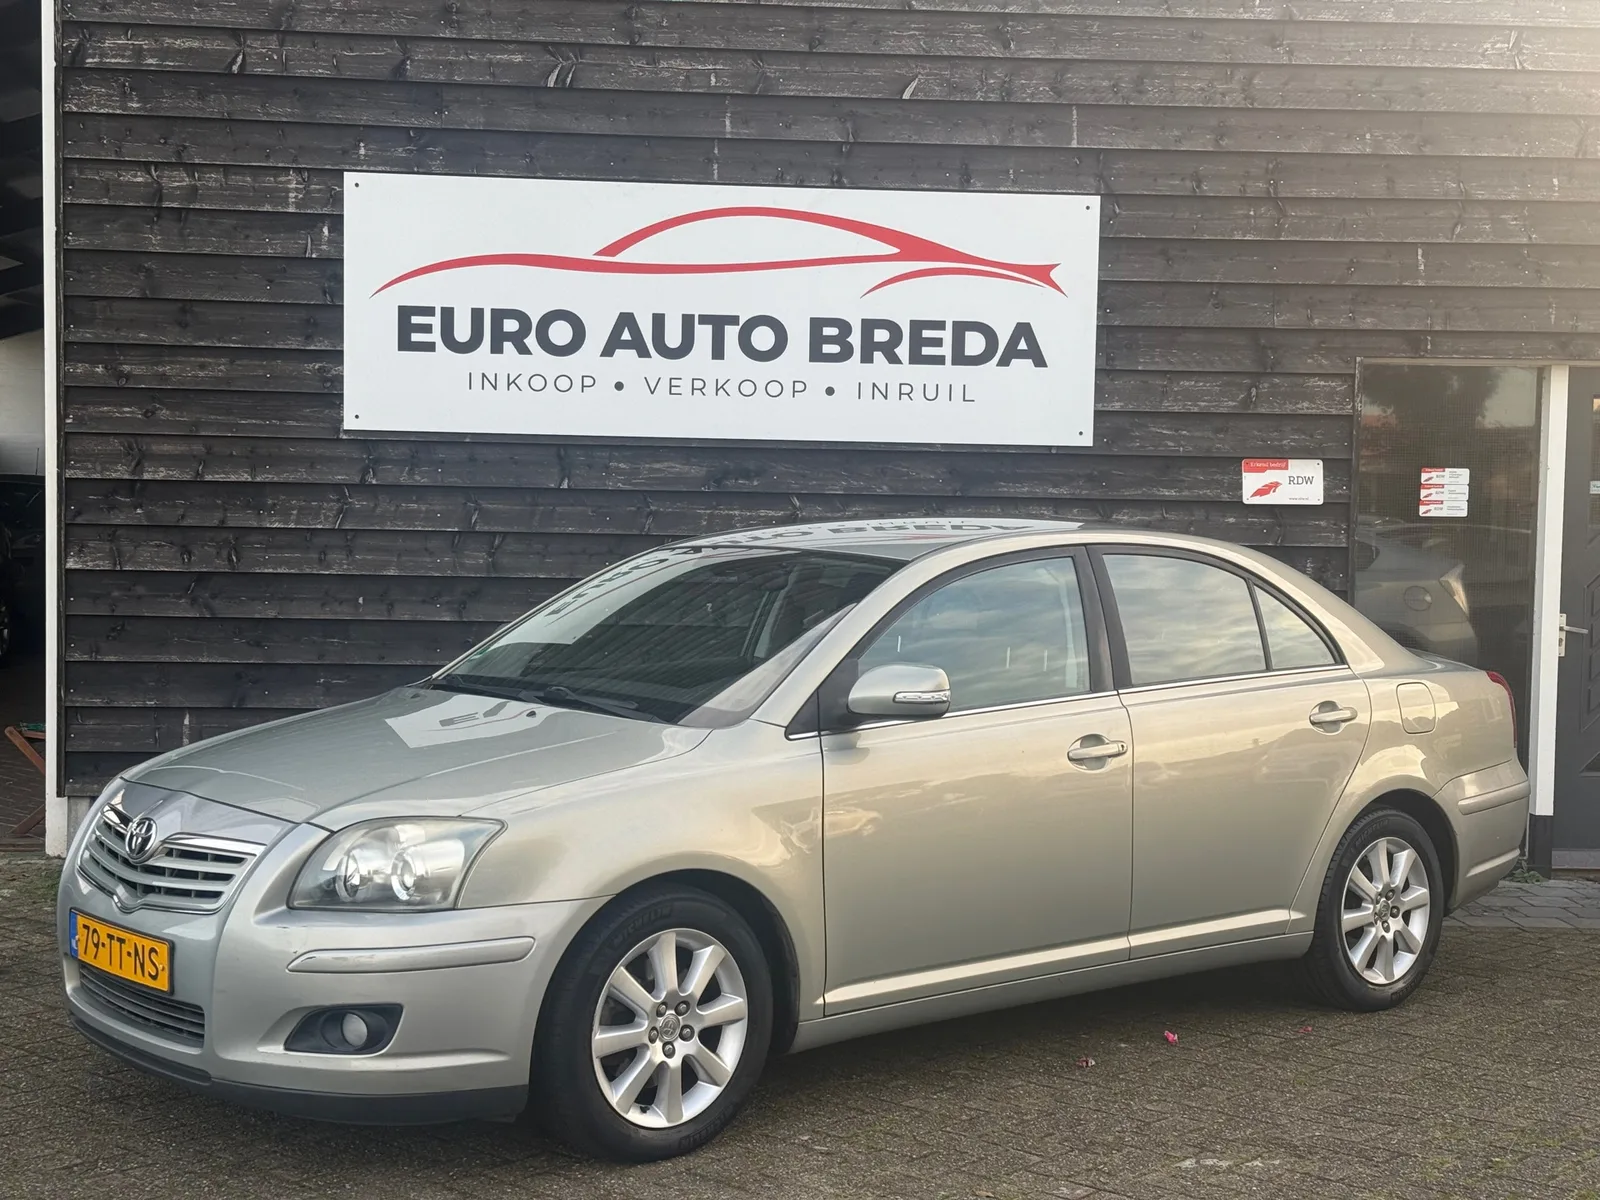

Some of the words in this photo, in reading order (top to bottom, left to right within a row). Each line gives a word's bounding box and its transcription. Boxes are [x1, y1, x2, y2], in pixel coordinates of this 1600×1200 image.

[398, 305, 586, 357] EURO
[600, 312, 788, 362] AUTO
[809, 317, 1048, 368] BREDA
[468, 372, 596, 393] INKOOP
[644, 377, 807, 398] VERKOOP
[857, 382, 976, 402] INRUIL
[1288, 475, 1315, 485] RDW
[82, 923, 160, 982] 79-TT-NS
